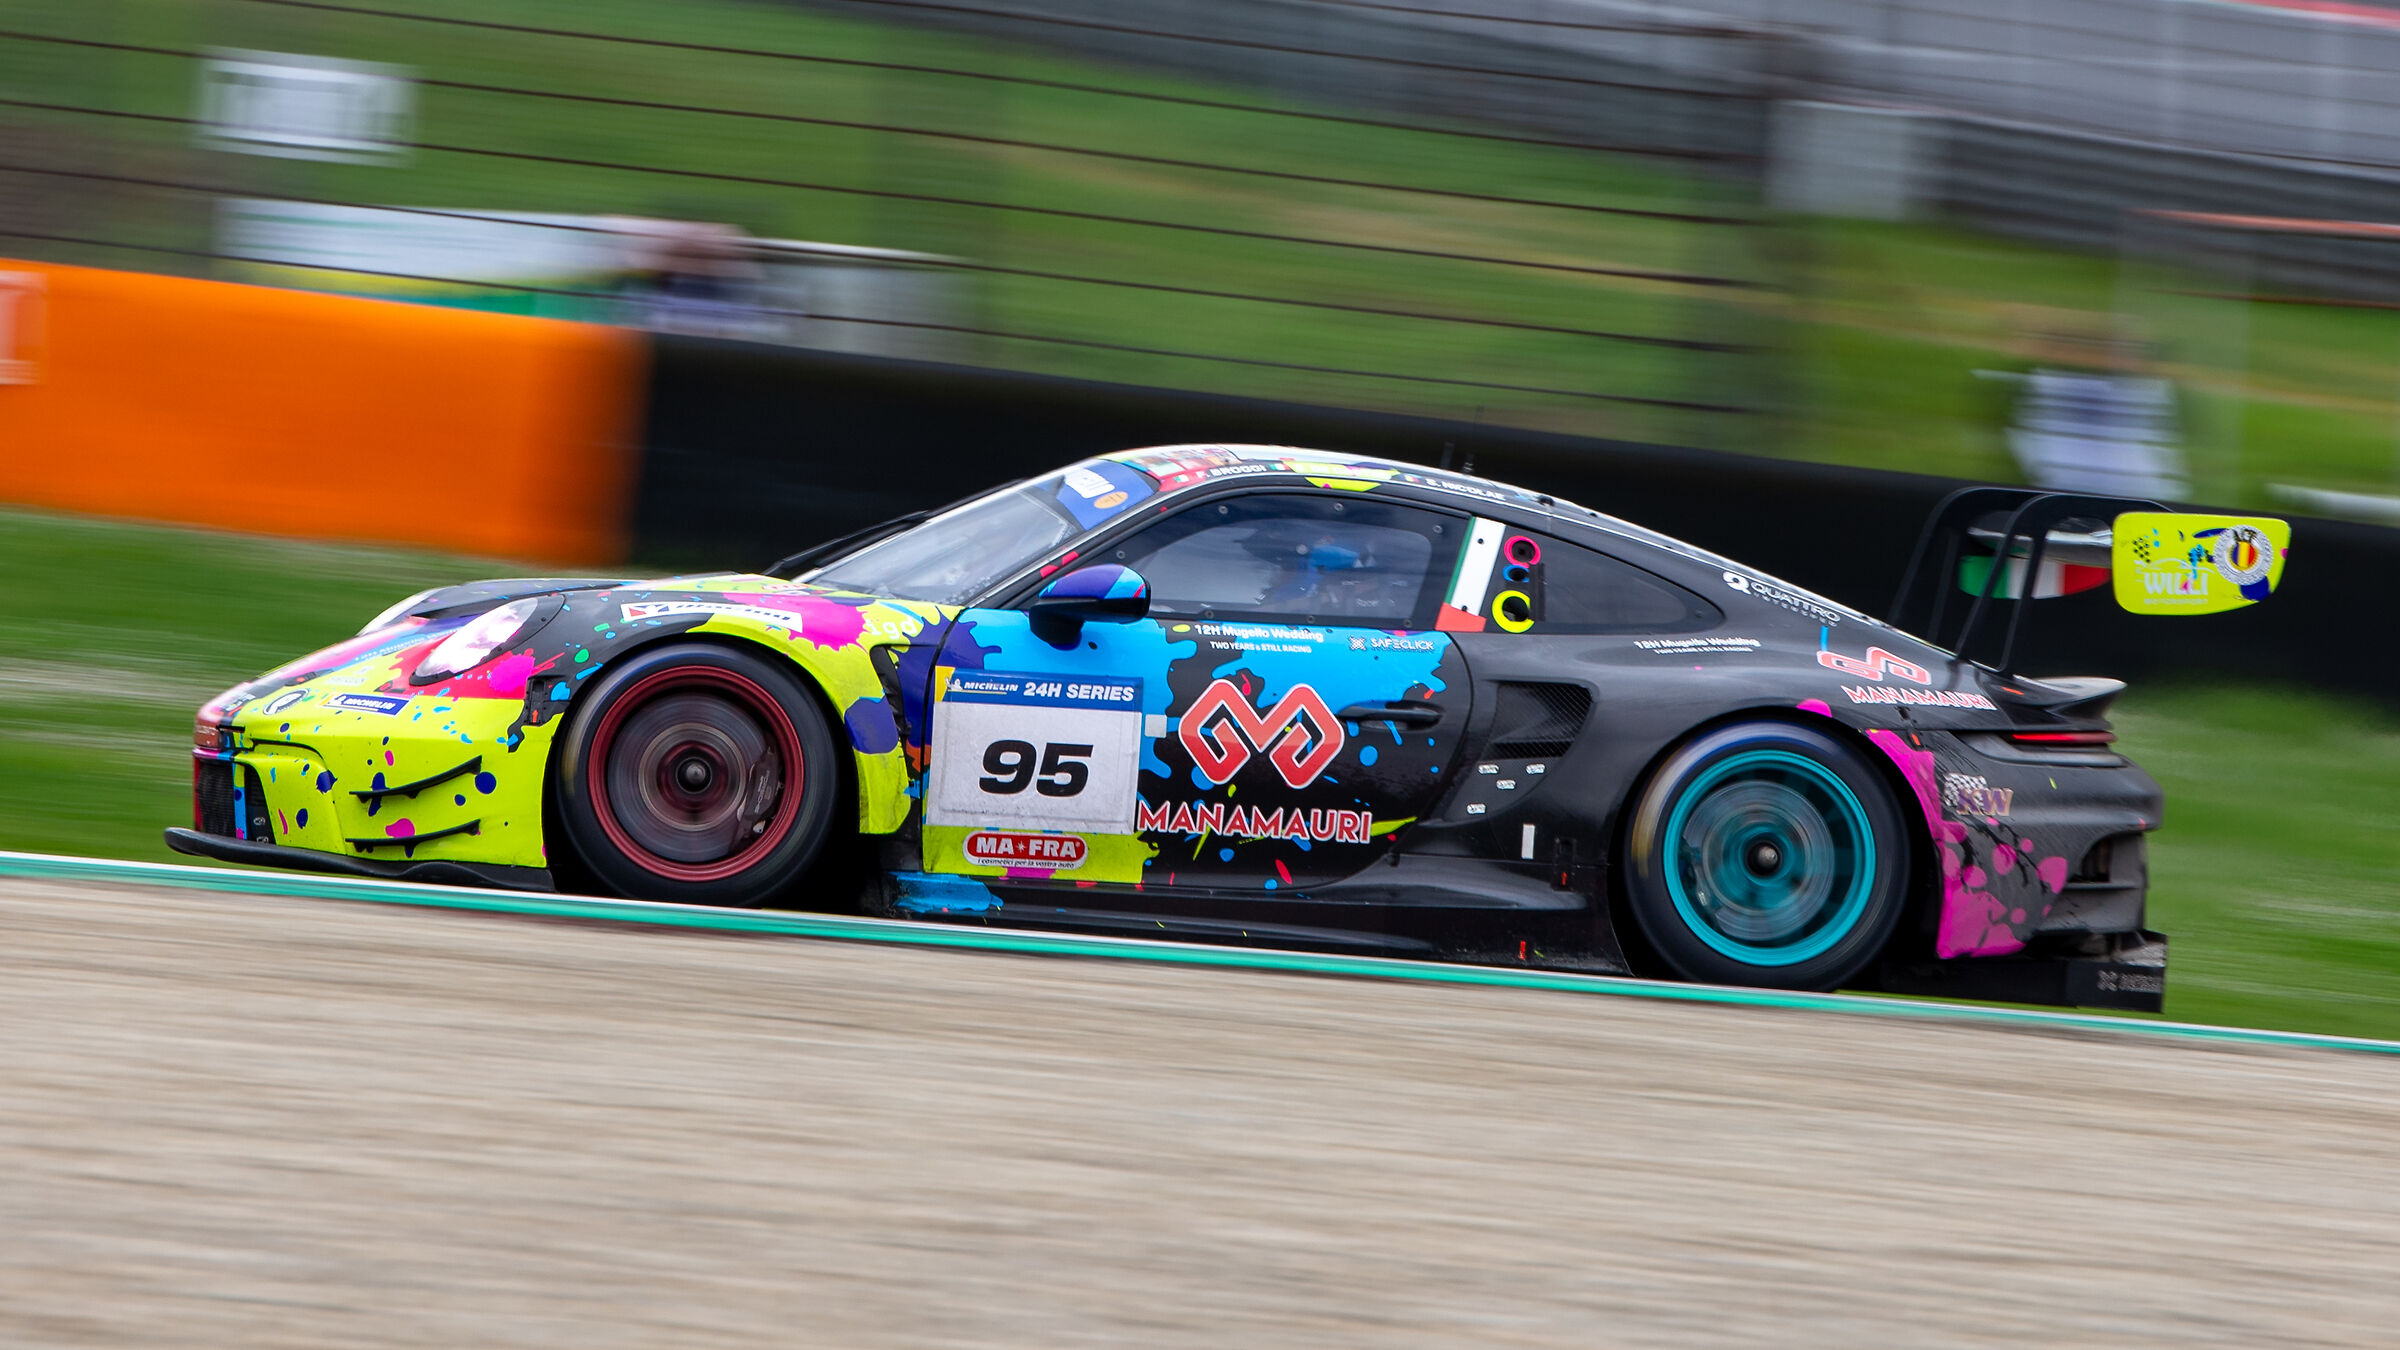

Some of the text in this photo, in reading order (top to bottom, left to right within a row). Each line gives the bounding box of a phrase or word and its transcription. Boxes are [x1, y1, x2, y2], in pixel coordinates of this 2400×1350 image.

[1208, 464, 1267, 476] BROGGI
[1441, 480, 1507, 501] NICOLAE
[2144, 572, 2209, 596] WILLI
[1751, 581, 1841, 623] QUATTRO
[1195, 624, 1325, 643] 12H Mugello Wedding
[1210, 640, 1230, 650] TWO
[1230, 642, 1256, 651] YEARS
[1262, 643, 1282, 652] STILL
[1282, 643, 1313, 653] RACING
[964, 681, 1135, 701] MICHELIN 24H SERIES
[1841, 685, 1998, 711] MANAMAURI
[342, 697, 396, 710] MICHELIN
[979, 739, 1094, 798] 95
[1137, 799, 1373, 844] MANAMAURI
